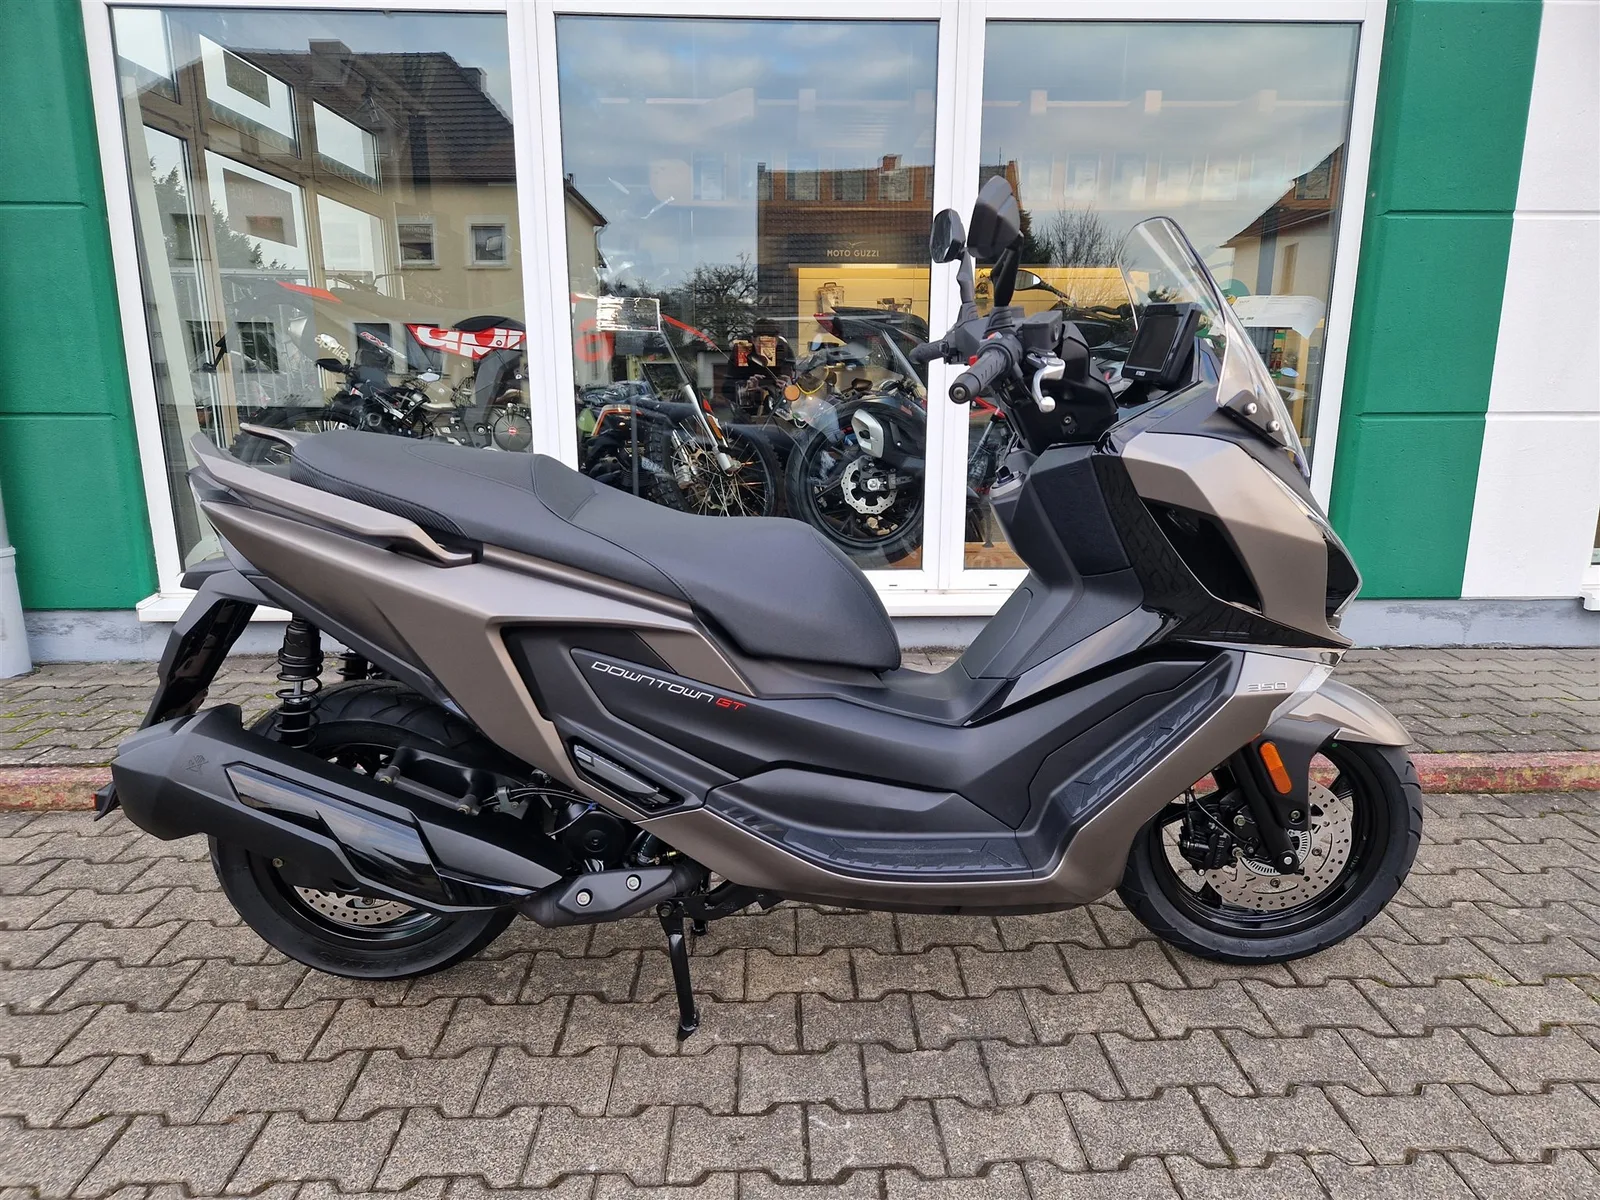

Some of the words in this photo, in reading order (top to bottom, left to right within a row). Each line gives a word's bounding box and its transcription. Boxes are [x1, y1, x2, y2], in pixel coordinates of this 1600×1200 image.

[826, 249, 851, 257] MOTO
[853, 249, 879, 257] GUZZI
[591, 661, 714, 703] DOWNTOWN
[715, 697, 747, 711] GT
[1247, 682, 1288, 693] 350
